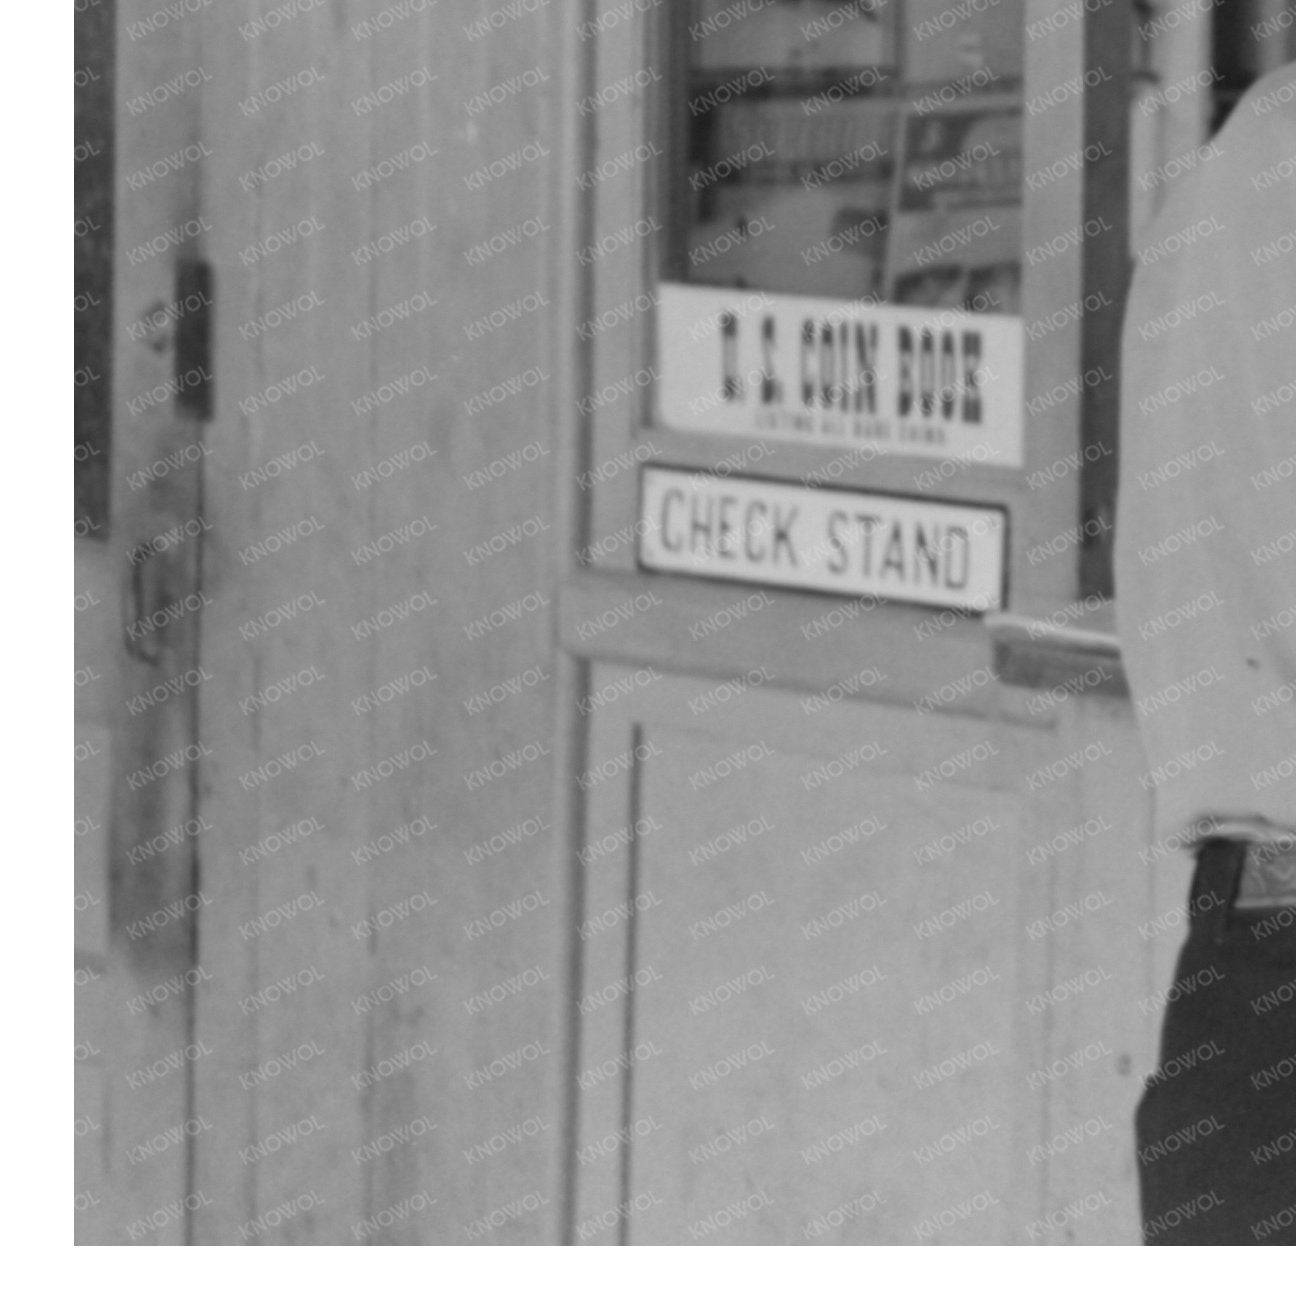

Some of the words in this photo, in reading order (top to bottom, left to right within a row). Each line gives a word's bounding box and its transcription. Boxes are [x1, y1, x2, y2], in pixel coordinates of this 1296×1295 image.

[801, 318, 877, 415] COIN
[898, 324, 983, 426] BOOK
[660, 488, 801, 570] CHECK
[825, 509, 970, 591] STAND
